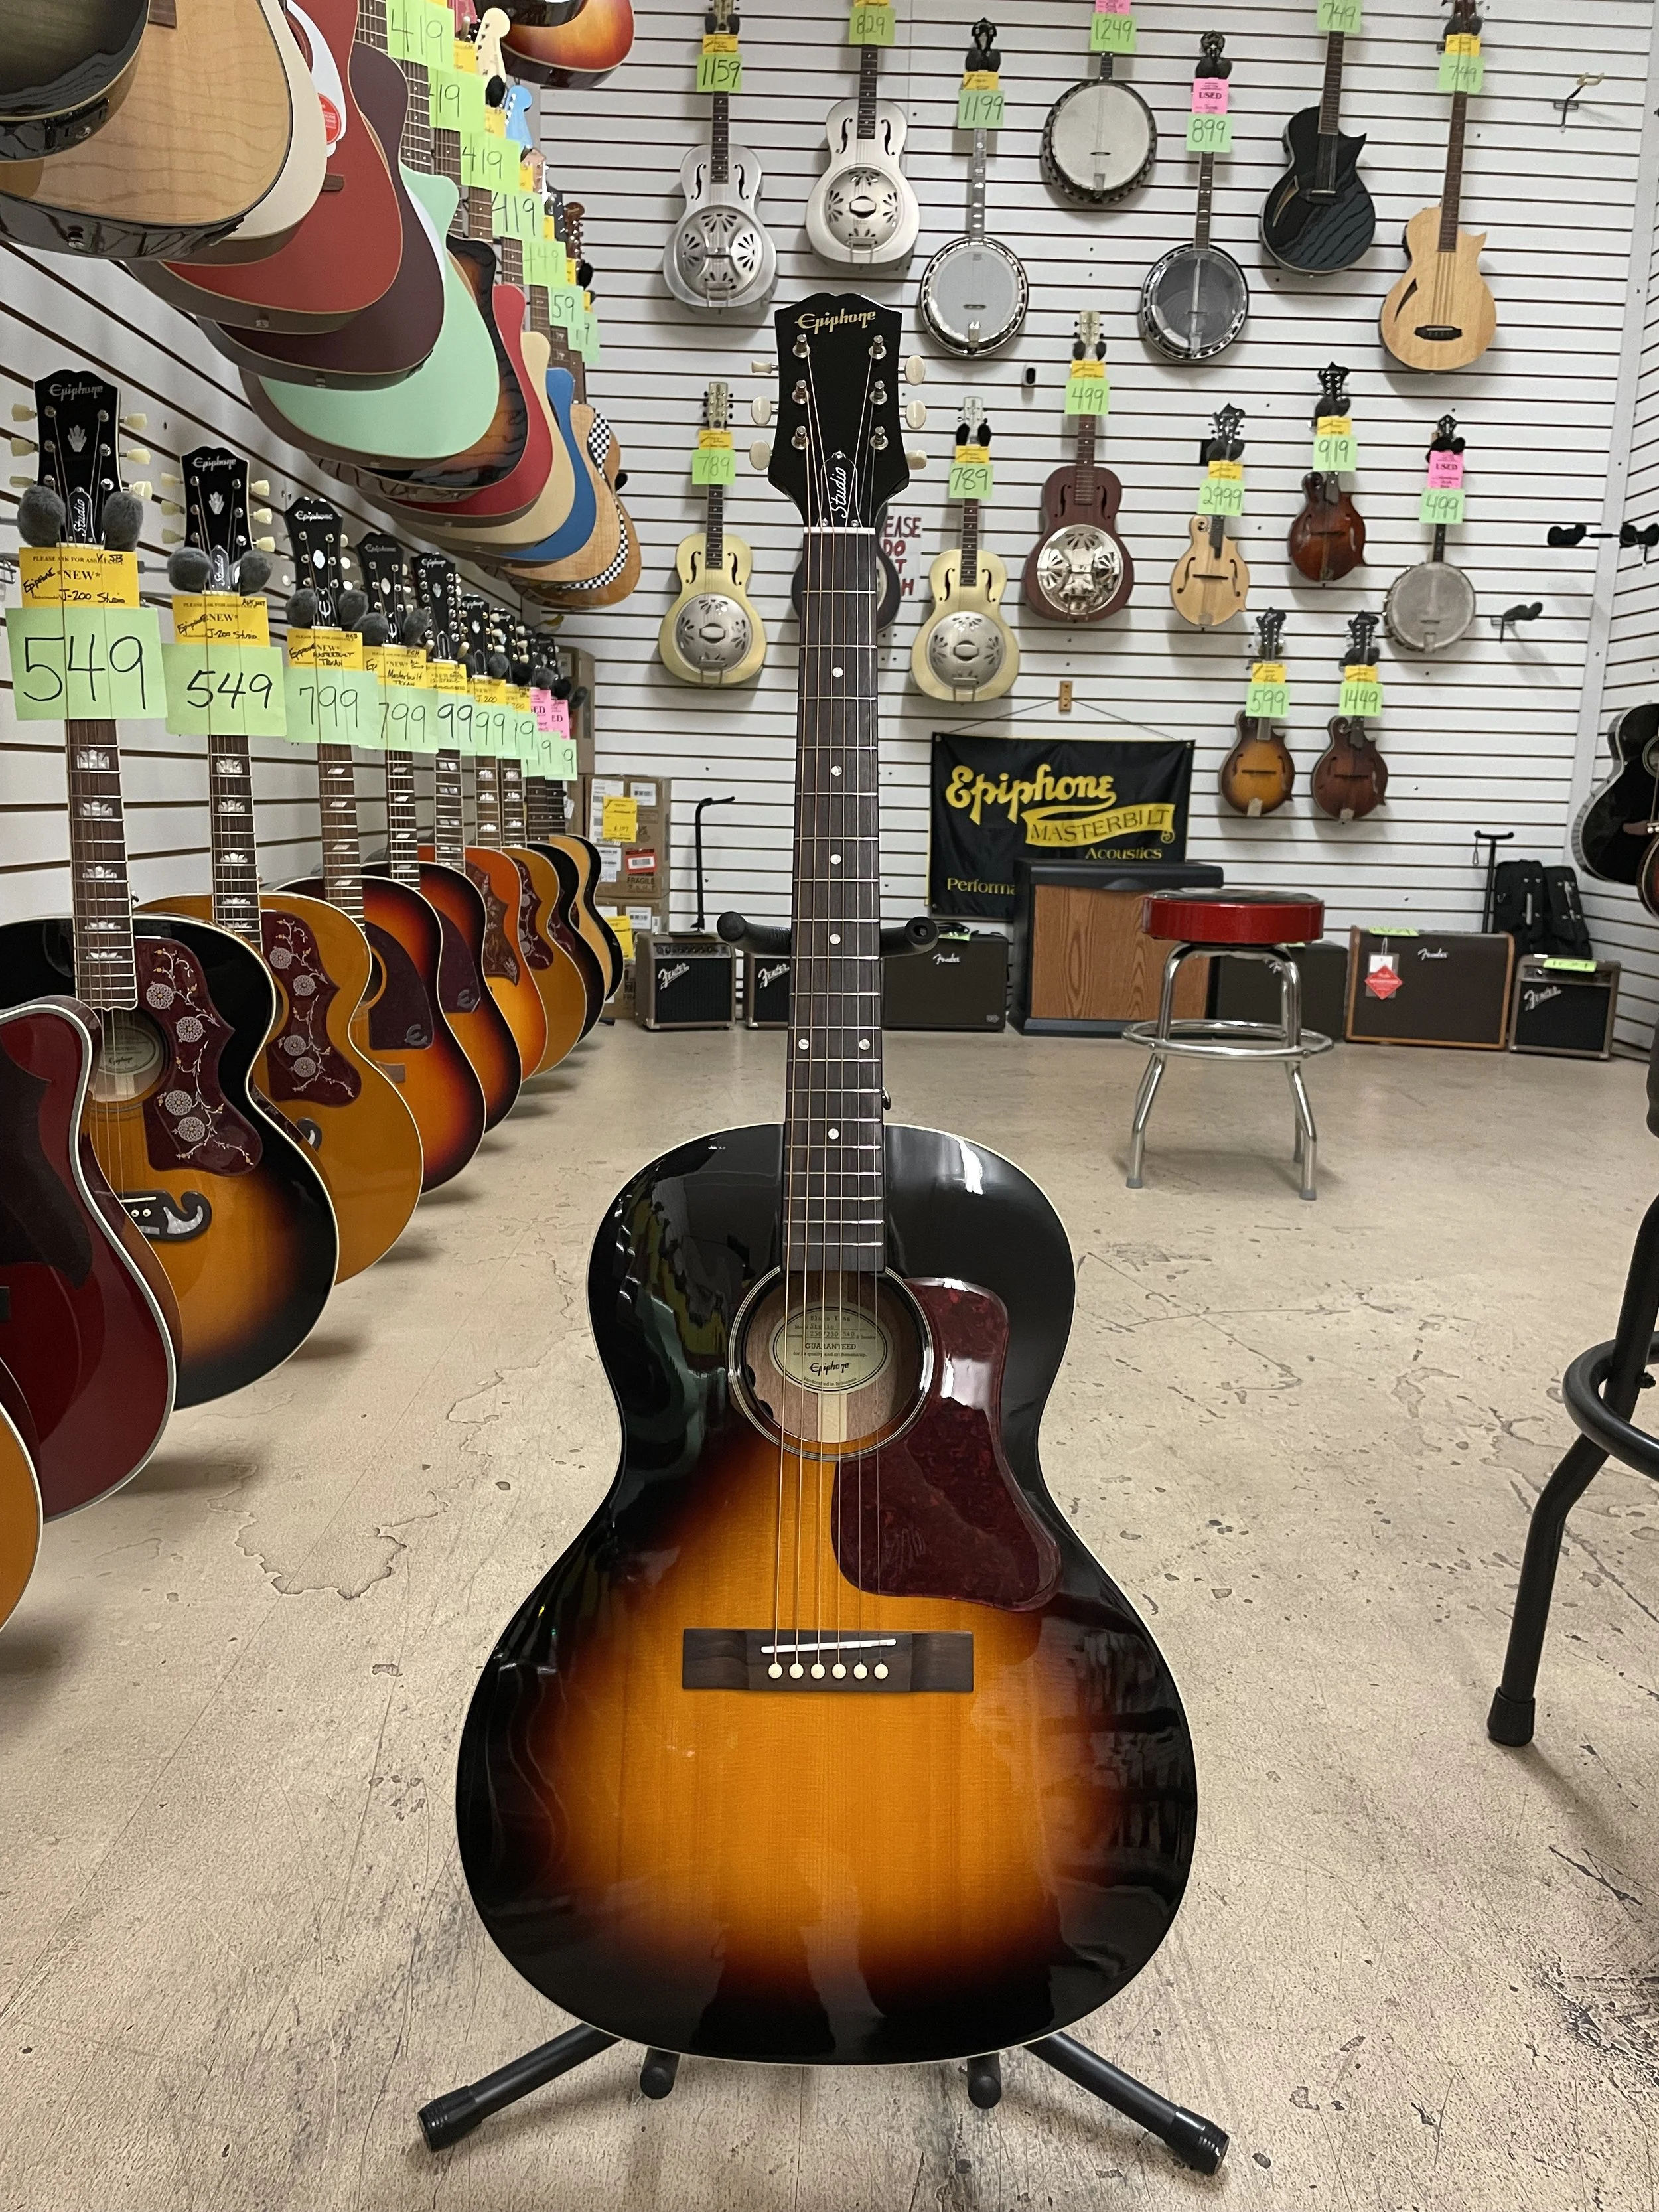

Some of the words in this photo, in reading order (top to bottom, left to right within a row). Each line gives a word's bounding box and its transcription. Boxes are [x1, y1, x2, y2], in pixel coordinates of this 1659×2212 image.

[856, 15, 885, 36] 829
[1323, 2, 1356, 27] 749
[391, 9, 443, 62] 419
[1095, 19, 1133, 42] 1249
[703, 58, 741, 88] 1159
[964, 95, 1003, 121] 1199
[1192, 119, 1226, 142] 899
[461, 146, 502, 179] 419
[492, 192, 536, 236] 419
[794, 307, 877, 334] Epiphone
[49, 384, 104, 400] Epiphone
[1072, 387, 1104, 411] 499
[192, 457, 236, 471] Epiphone
[1318, 439, 1349, 463] 919
[697, 456, 730, 477] 789
[951, 467, 987, 492] 789
[830, 466, 847, 518] Studio
[1202, 486, 1242, 510] 2999
[74, 498, 86, 536] Studio
[295, 510, 333, 522] Epiphone
[1425, 494, 1459, 520] 499
[364, 543, 396, 553] Epiphone
[883, 538, 907, 557] DO
[214, 554, 224, 586] Studio
[59, 589, 92, 601] J-200
[23, 634, 146, 710] 549
[186, 670, 273, 709] 549
[1250, 689, 1285, 715] 599
[1344, 688, 1378, 713] 1449
[299, 686, 358, 728] 799
[378, 702, 426, 743] 799
[945, 763, 1117, 826] Epiphone
[1030, 808, 1171, 842] MASTERBILT
[1084, 847, 1163, 860] Acoustics
[657, 962, 691, 990] Fender
[758, 962, 790, 990] Fender
[809, 1360, 850, 1376] Epiphone
